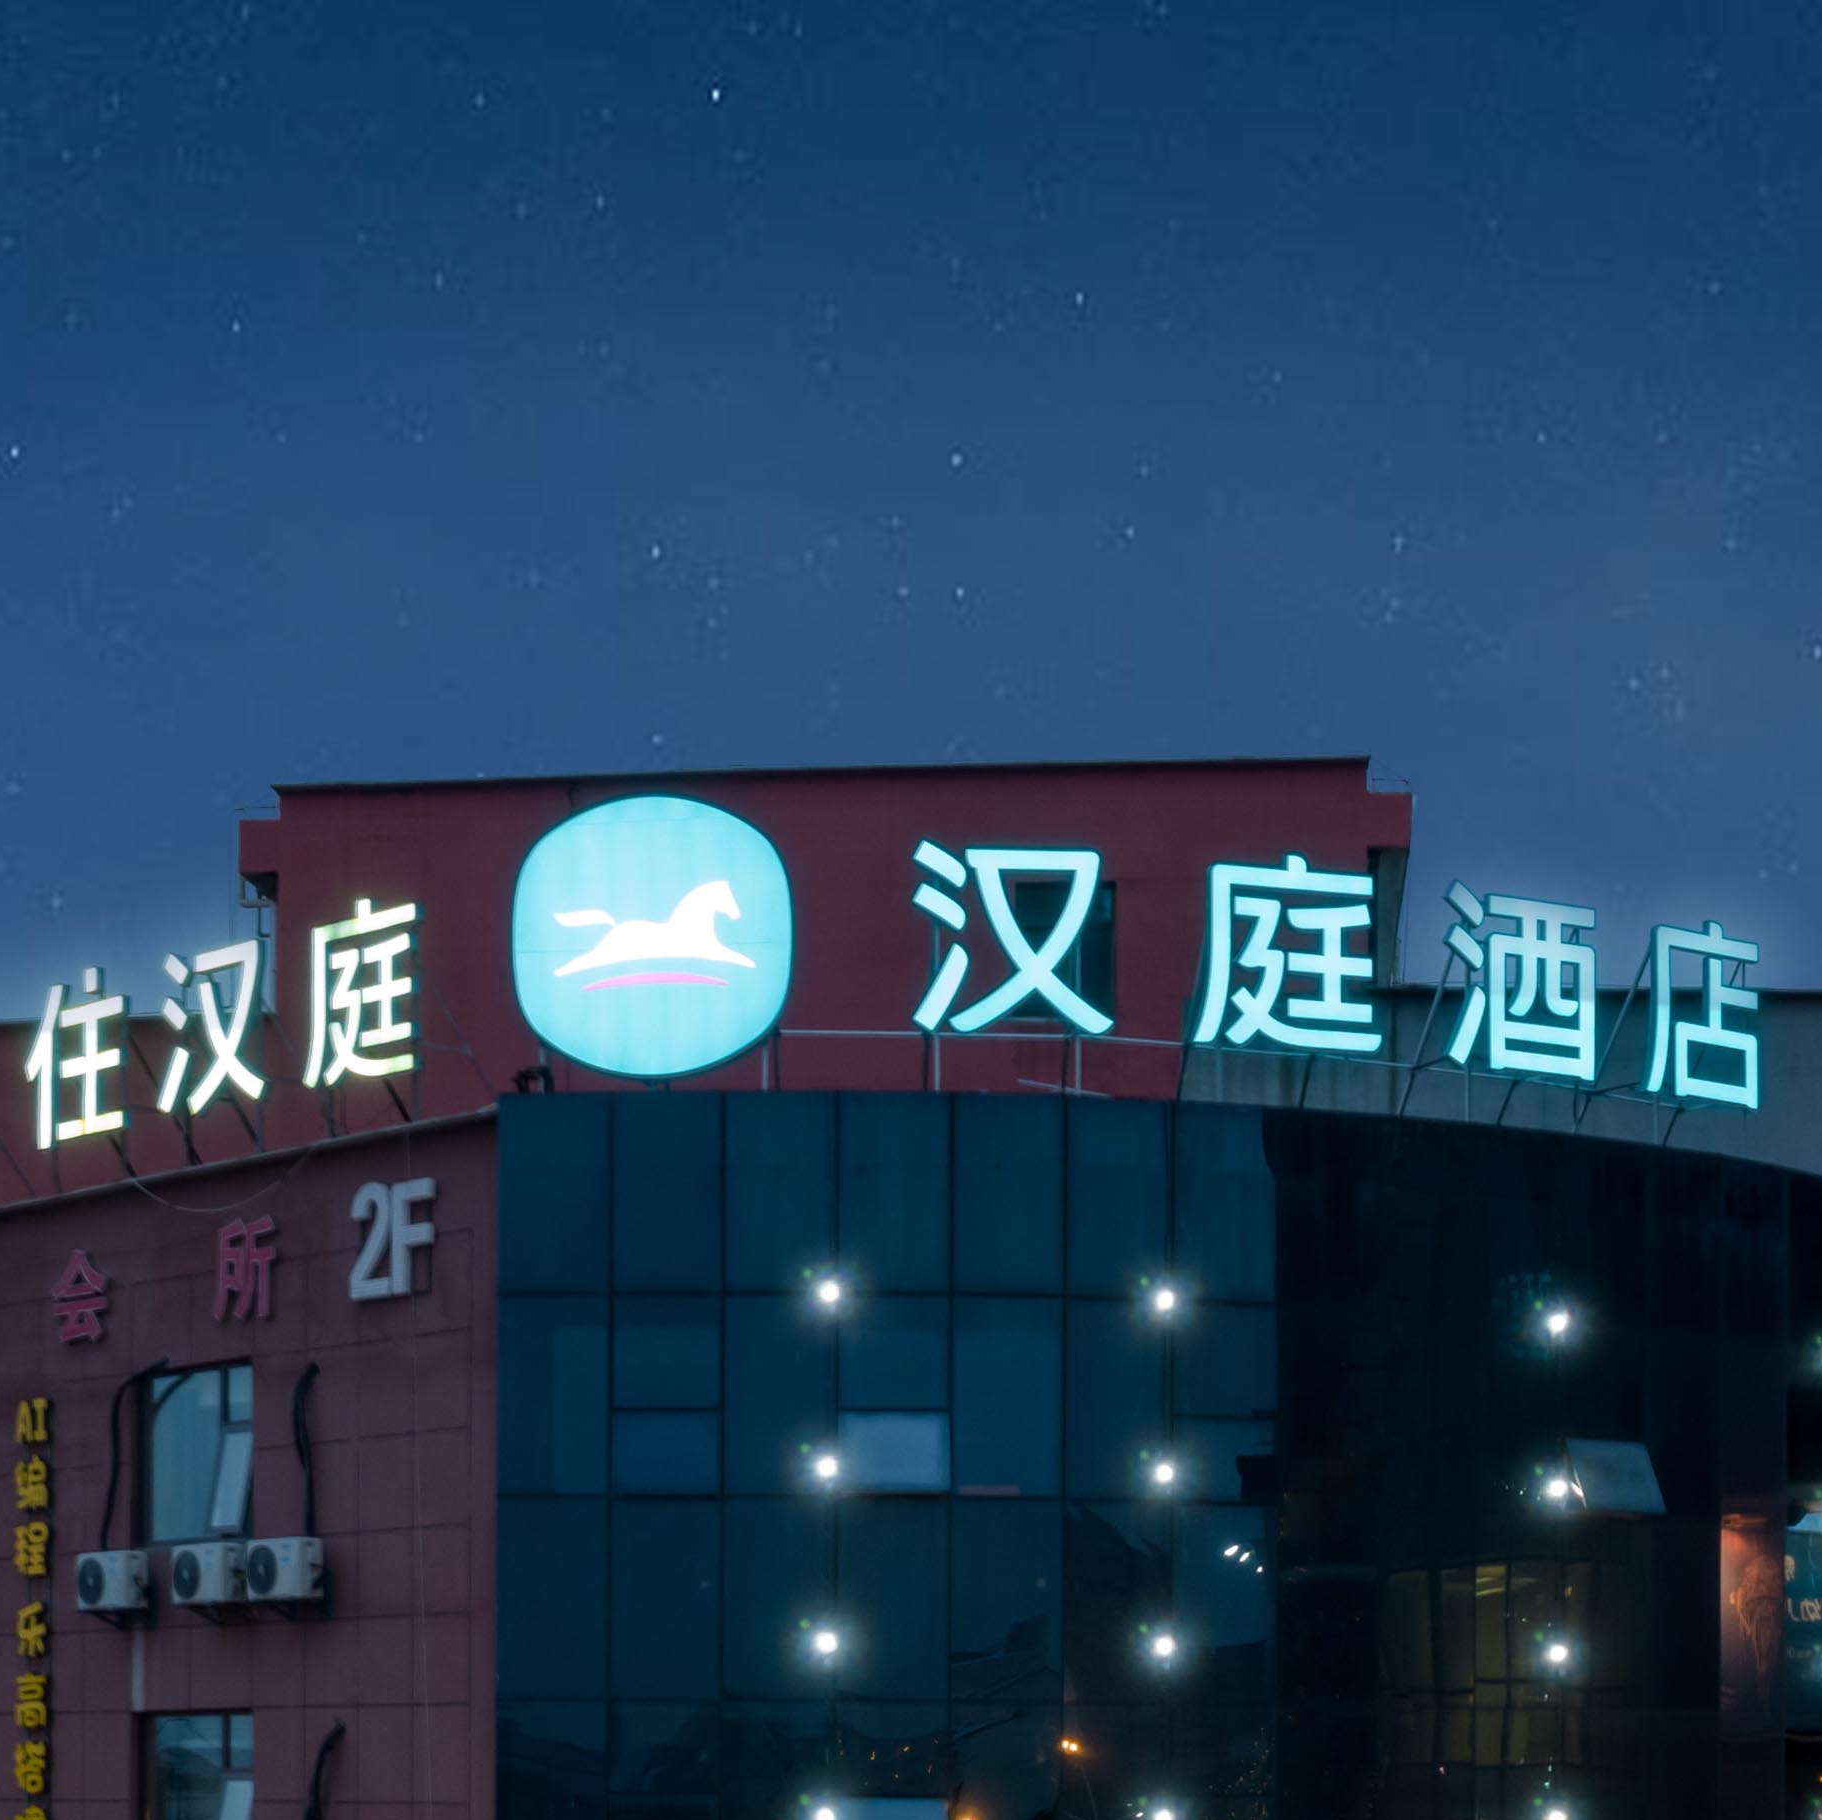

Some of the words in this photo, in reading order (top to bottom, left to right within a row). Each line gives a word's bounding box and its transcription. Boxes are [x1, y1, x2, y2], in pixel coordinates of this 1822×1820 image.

[24, 898, 422, 1150] 住汉庭
[911, 838, 1762, 1111] 汉庭酒店
[348, 1176, 436, 1302] 2F
